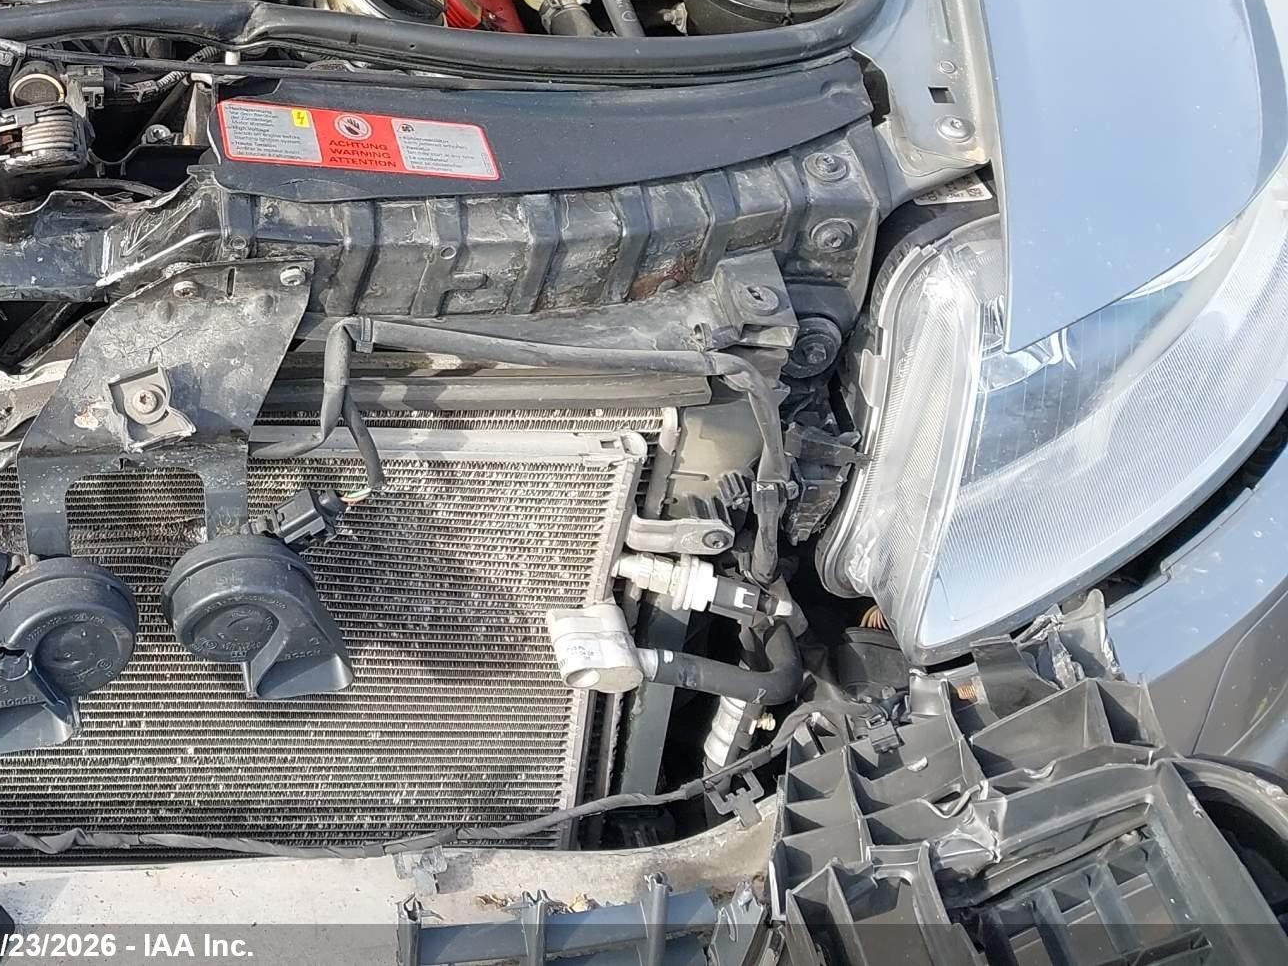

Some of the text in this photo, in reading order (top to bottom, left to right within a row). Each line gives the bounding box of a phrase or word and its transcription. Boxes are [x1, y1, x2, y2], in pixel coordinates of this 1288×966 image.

[329, 140, 388, 150] ACHTUNG
[329, 148, 392, 159] WARNING
[329, 156, 397, 167] ATTENTION
